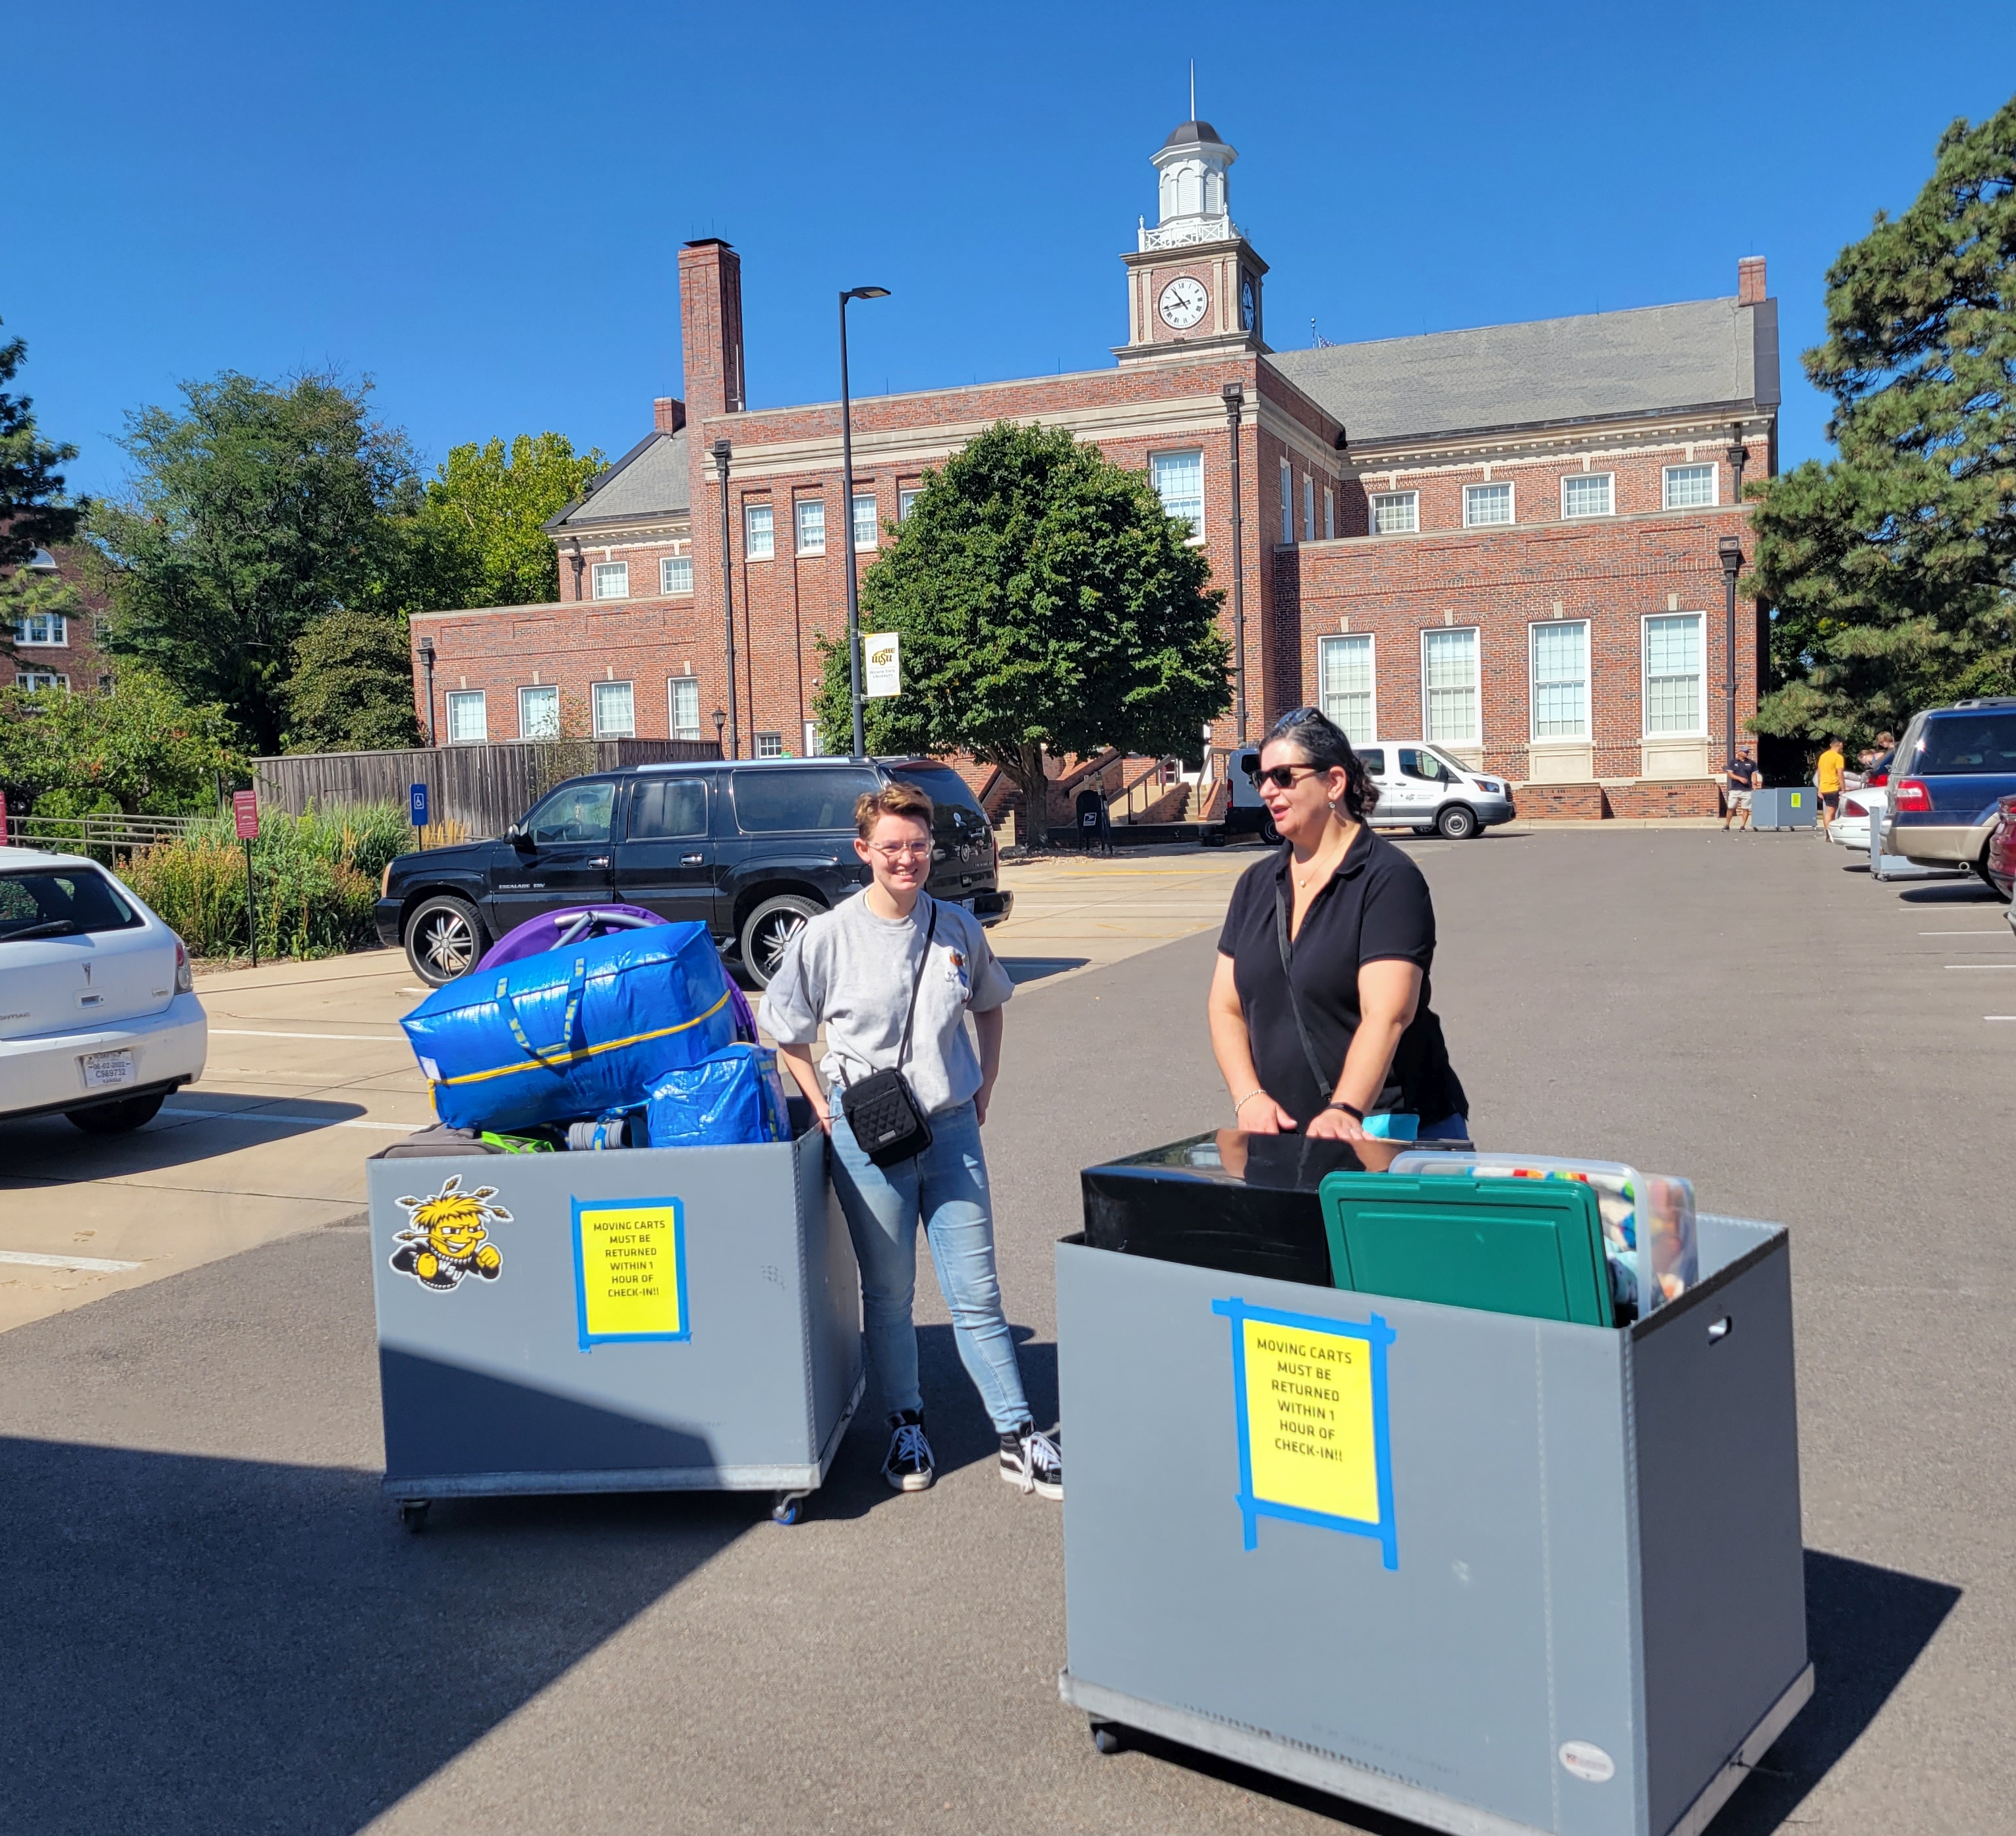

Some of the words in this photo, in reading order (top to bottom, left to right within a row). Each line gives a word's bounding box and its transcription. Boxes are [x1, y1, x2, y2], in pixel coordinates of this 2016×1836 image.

[594, 1222, 631, 1231] MOVING
[635, 1220, 665, 1229] CARTS
[610, 1235, 636, 1244] MUST
[606, 1248, 656, 1257] RETURNED
[438, 1259, 463, 1282] WSU
[608, 1287, 659, 1297] CHECK-IN!!
[1257, 1338, 1306, 1356] MOVING
[1310, 1347, 1352, 1364] CARTS
[1277, 1360, 1311, 1377] MUST
[1316, 1367, 1331, 1381] BE
[1271, 1379, 1339, 1402] RETURNED
[1277, 1399, 1325, 1419] WITHIN
[1330, 1410, 1335, 1421] 1
[1280, 1419, 1315, 1437] HOUR
[1319, 1427, 1335, 1440] OF
[1275, 1438, 1342, 1462] CHECK-IN!!
